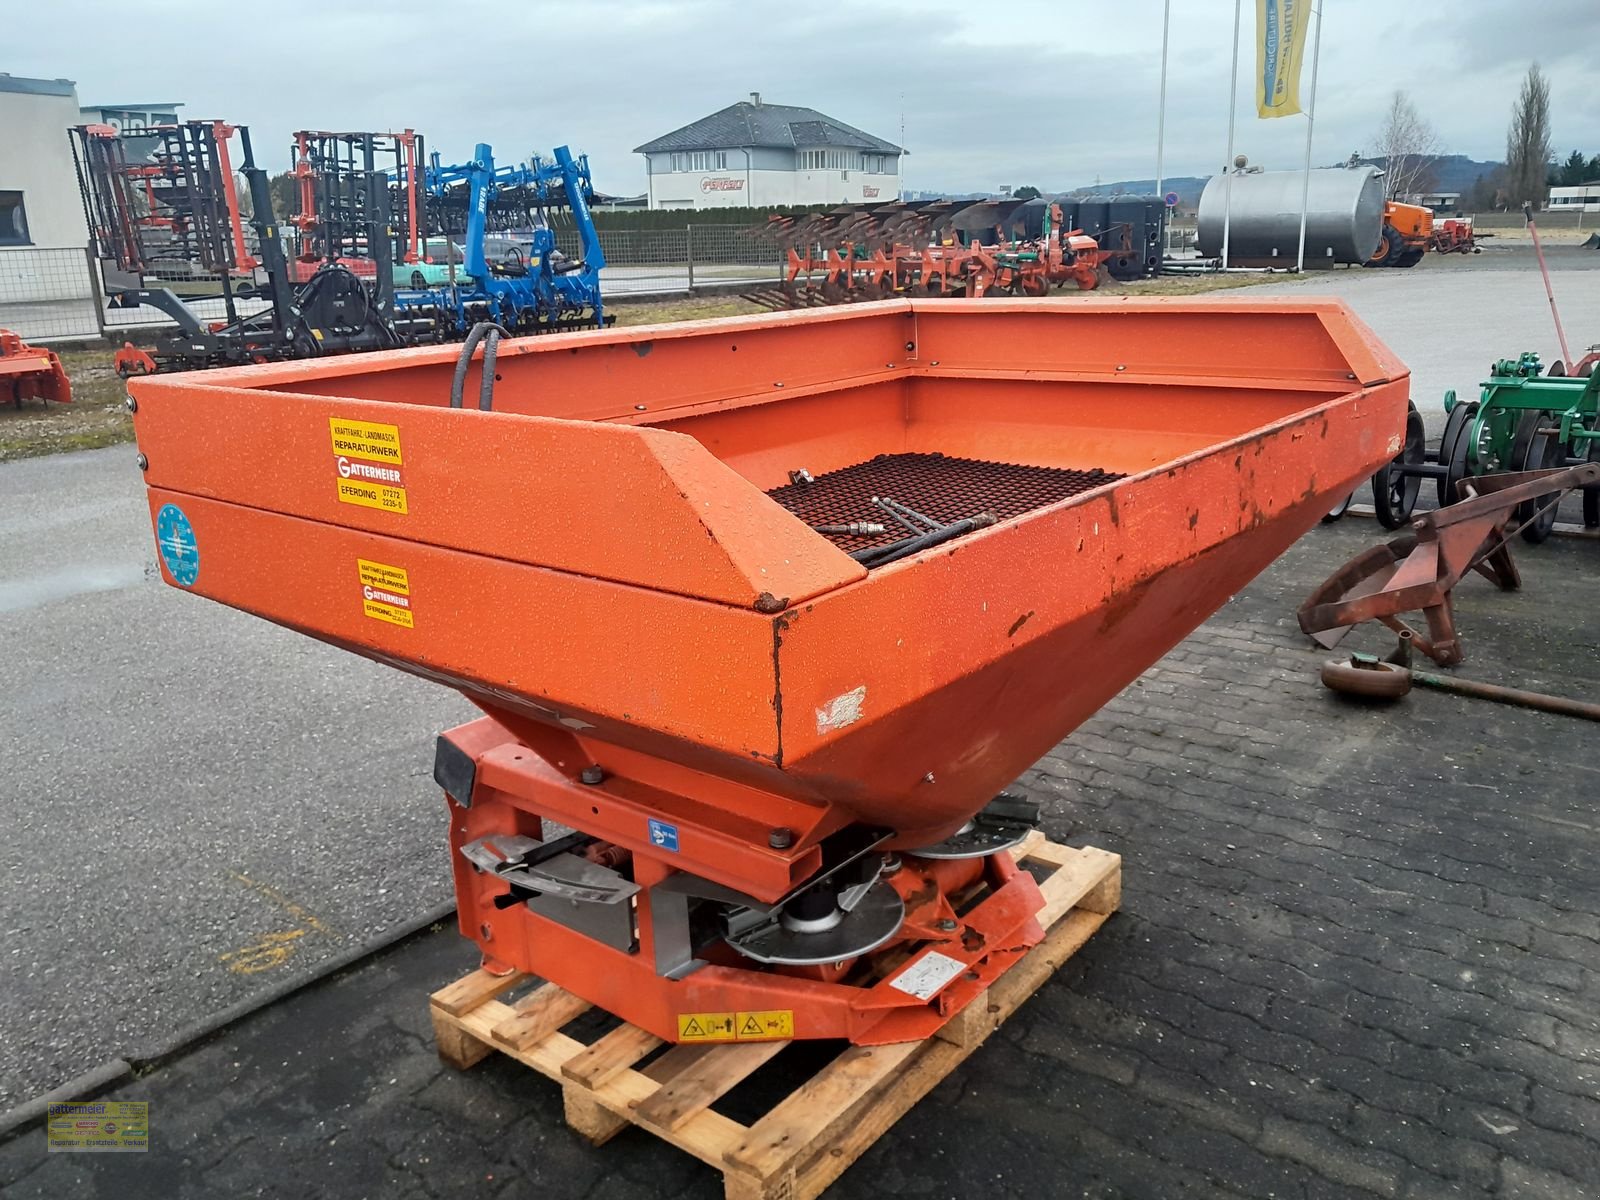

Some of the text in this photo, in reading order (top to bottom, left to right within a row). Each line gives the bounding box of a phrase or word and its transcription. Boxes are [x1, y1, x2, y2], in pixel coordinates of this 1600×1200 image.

[335, 440, 399, 458] REPARATURWERK
[338, 457, 401, 482] GATTERMEIER
[341, 485, 377, 500] EFERDING
[382, 489, 400, 499] 07272
